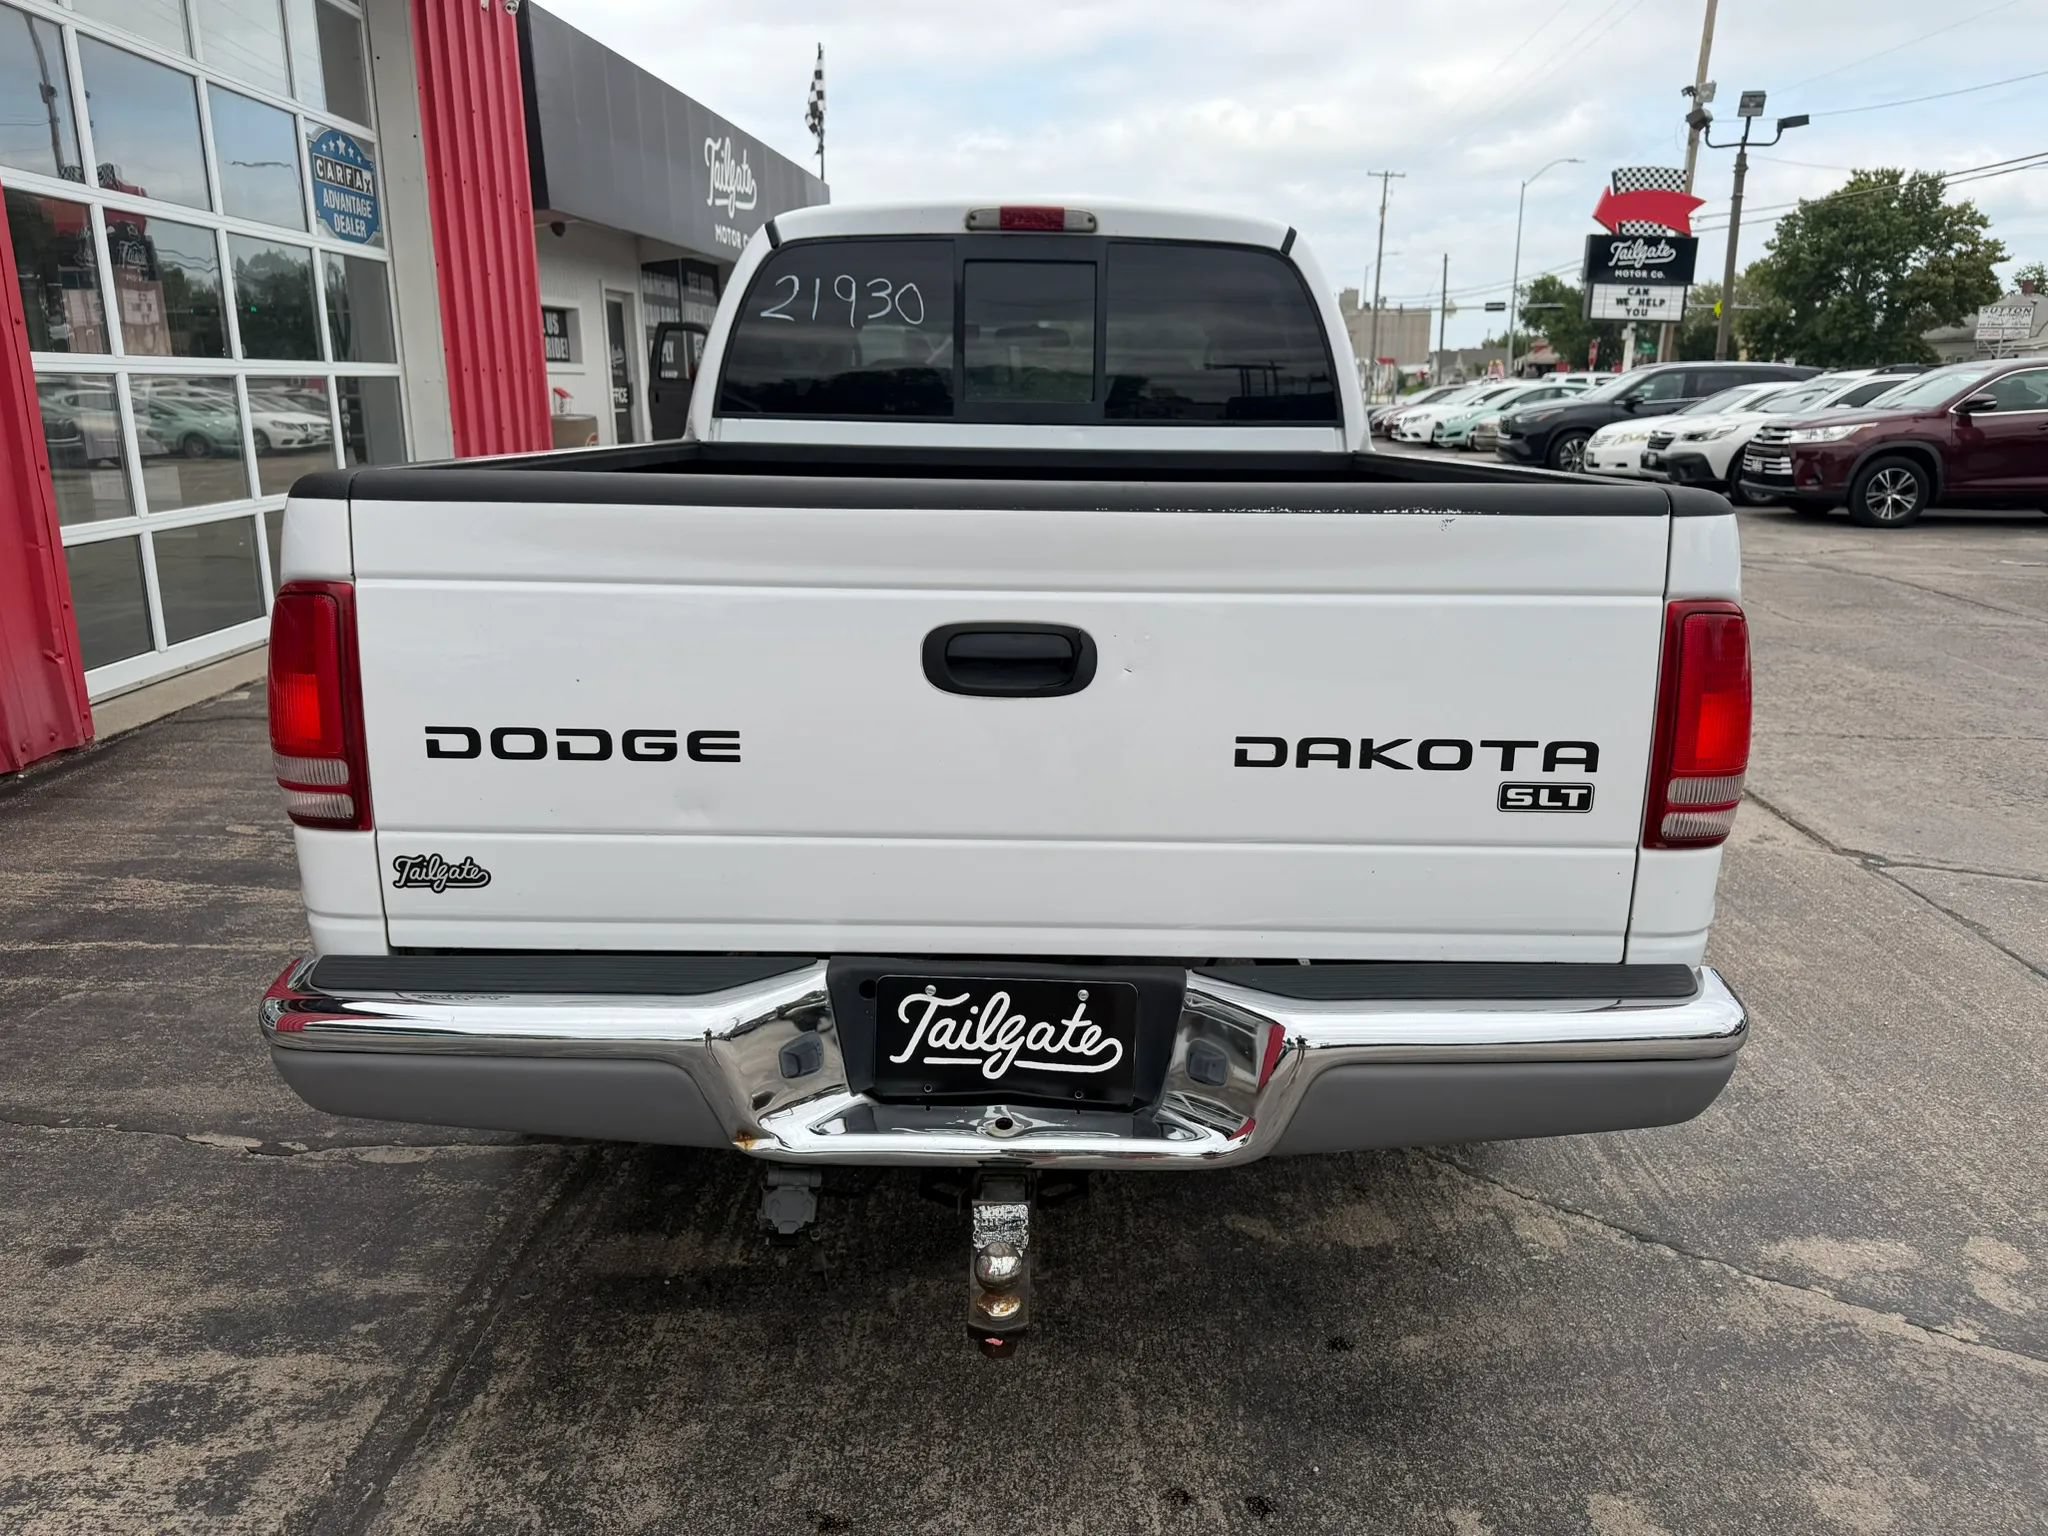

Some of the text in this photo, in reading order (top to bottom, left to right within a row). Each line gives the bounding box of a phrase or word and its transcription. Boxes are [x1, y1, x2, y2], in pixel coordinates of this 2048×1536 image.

[315, 158, 374, 194] CARFAX
[704, 137, 757, 219] Tailgate
[322, 188, 374, 218] ADVANTAGE
[333, 213, 367, 238] DEALER
[715, 224, 742, 249] MOTOR
[1608, 238, 1677, 268] Tailgate
[1614, 269, 1648, 279] MOTOR
[760, 275, 925, 328] 21930
[1616, 298, 1665, 307] WE HELP
[1627, 287, 1650, 296] CAN
[545, 312, 560, 335] US
[1626, 308, 1648, 317] YOU
[1981, 306, 2032, 314] SUTTON
[425, 726, 741, 762] DODGE
[1234, 736, 1600, 773] DAKOTA
[1505, 788, 1588, 808] SLT
[393, 853, 491, 893] Tailgate
[889, 991, 1123, 1080] Tailgate
